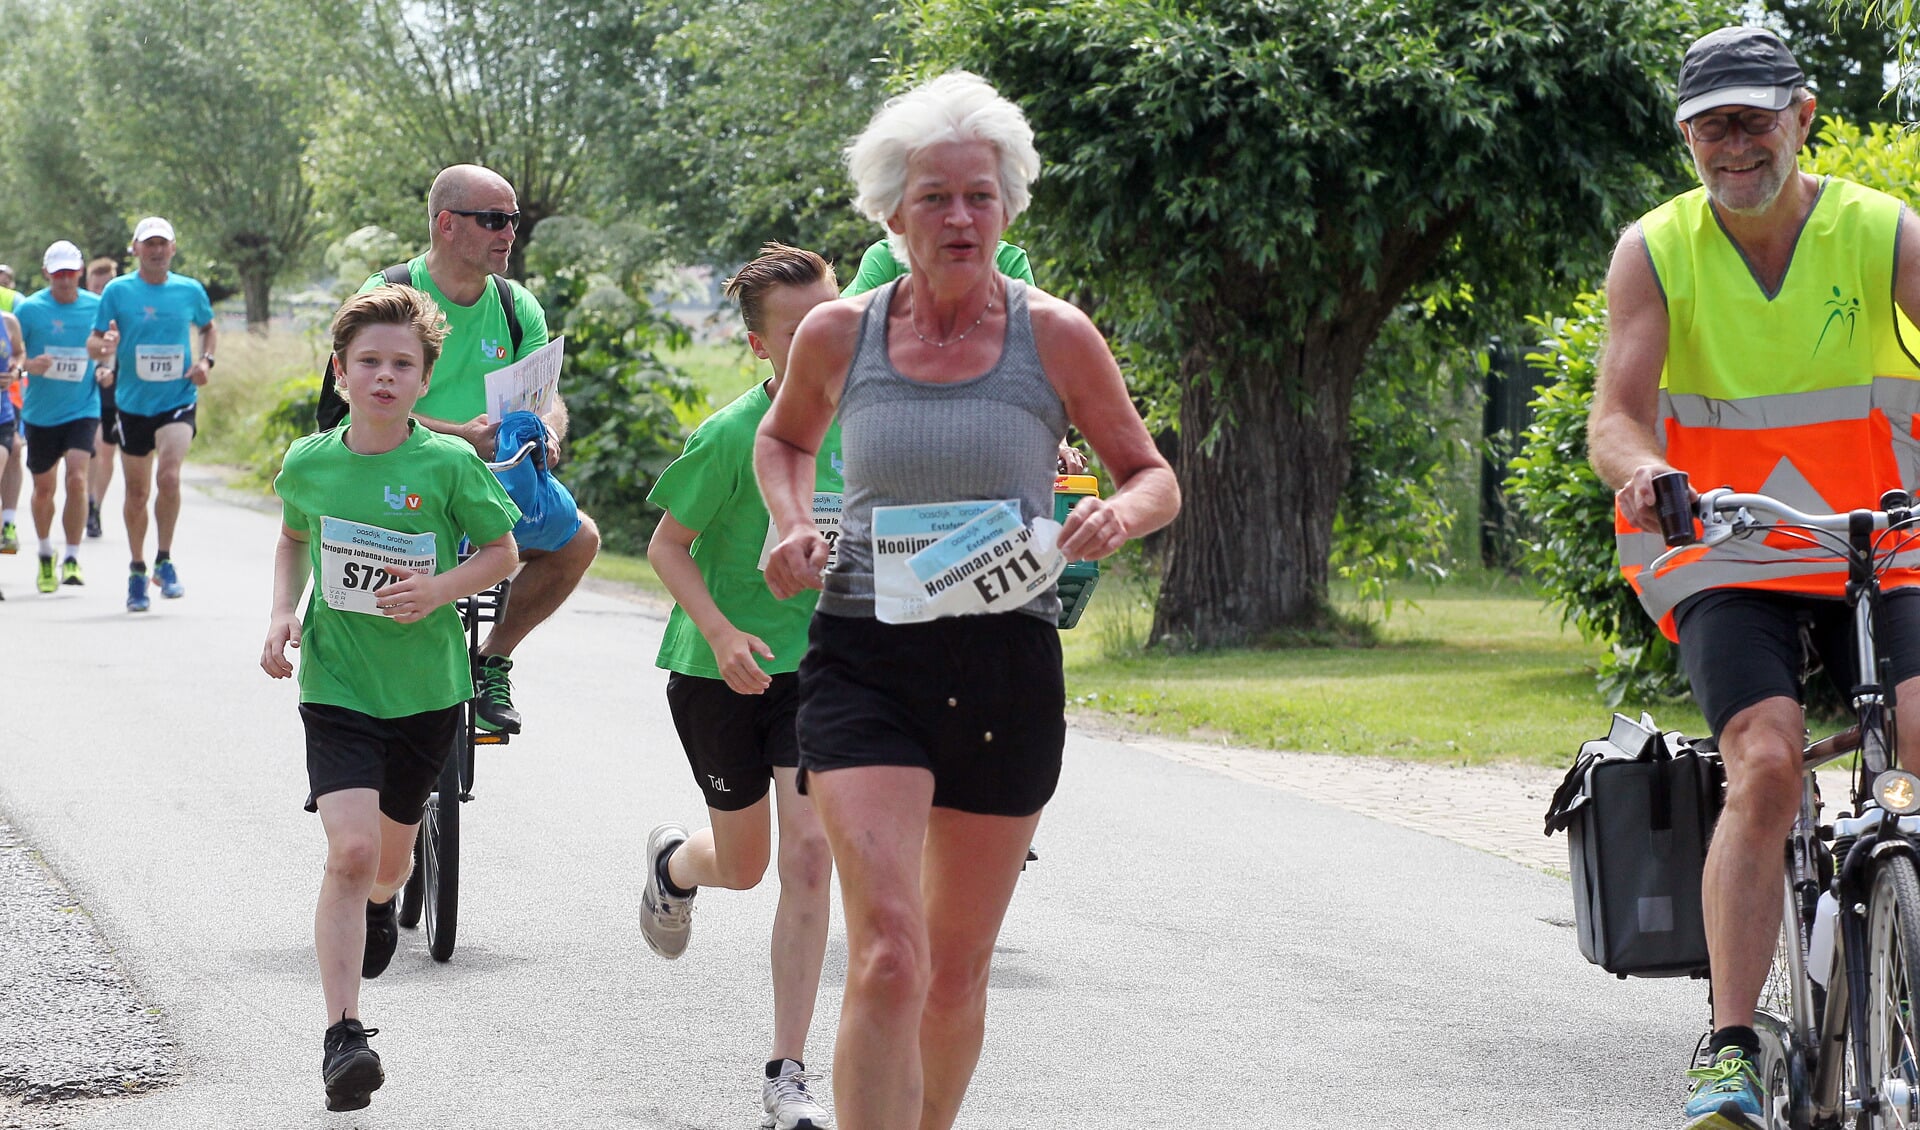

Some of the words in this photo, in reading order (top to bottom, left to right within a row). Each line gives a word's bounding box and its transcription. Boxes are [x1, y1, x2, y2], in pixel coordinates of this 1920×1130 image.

[353, 548, 382, 562] Johanna
[383, 555, 407, 567] locatie
[925, 552, 993, 597] Hooijman
[993, 540, 1013, 557] en
[973, 548, 1041, 604] E711
[707, 774, 731, 791] TdL
